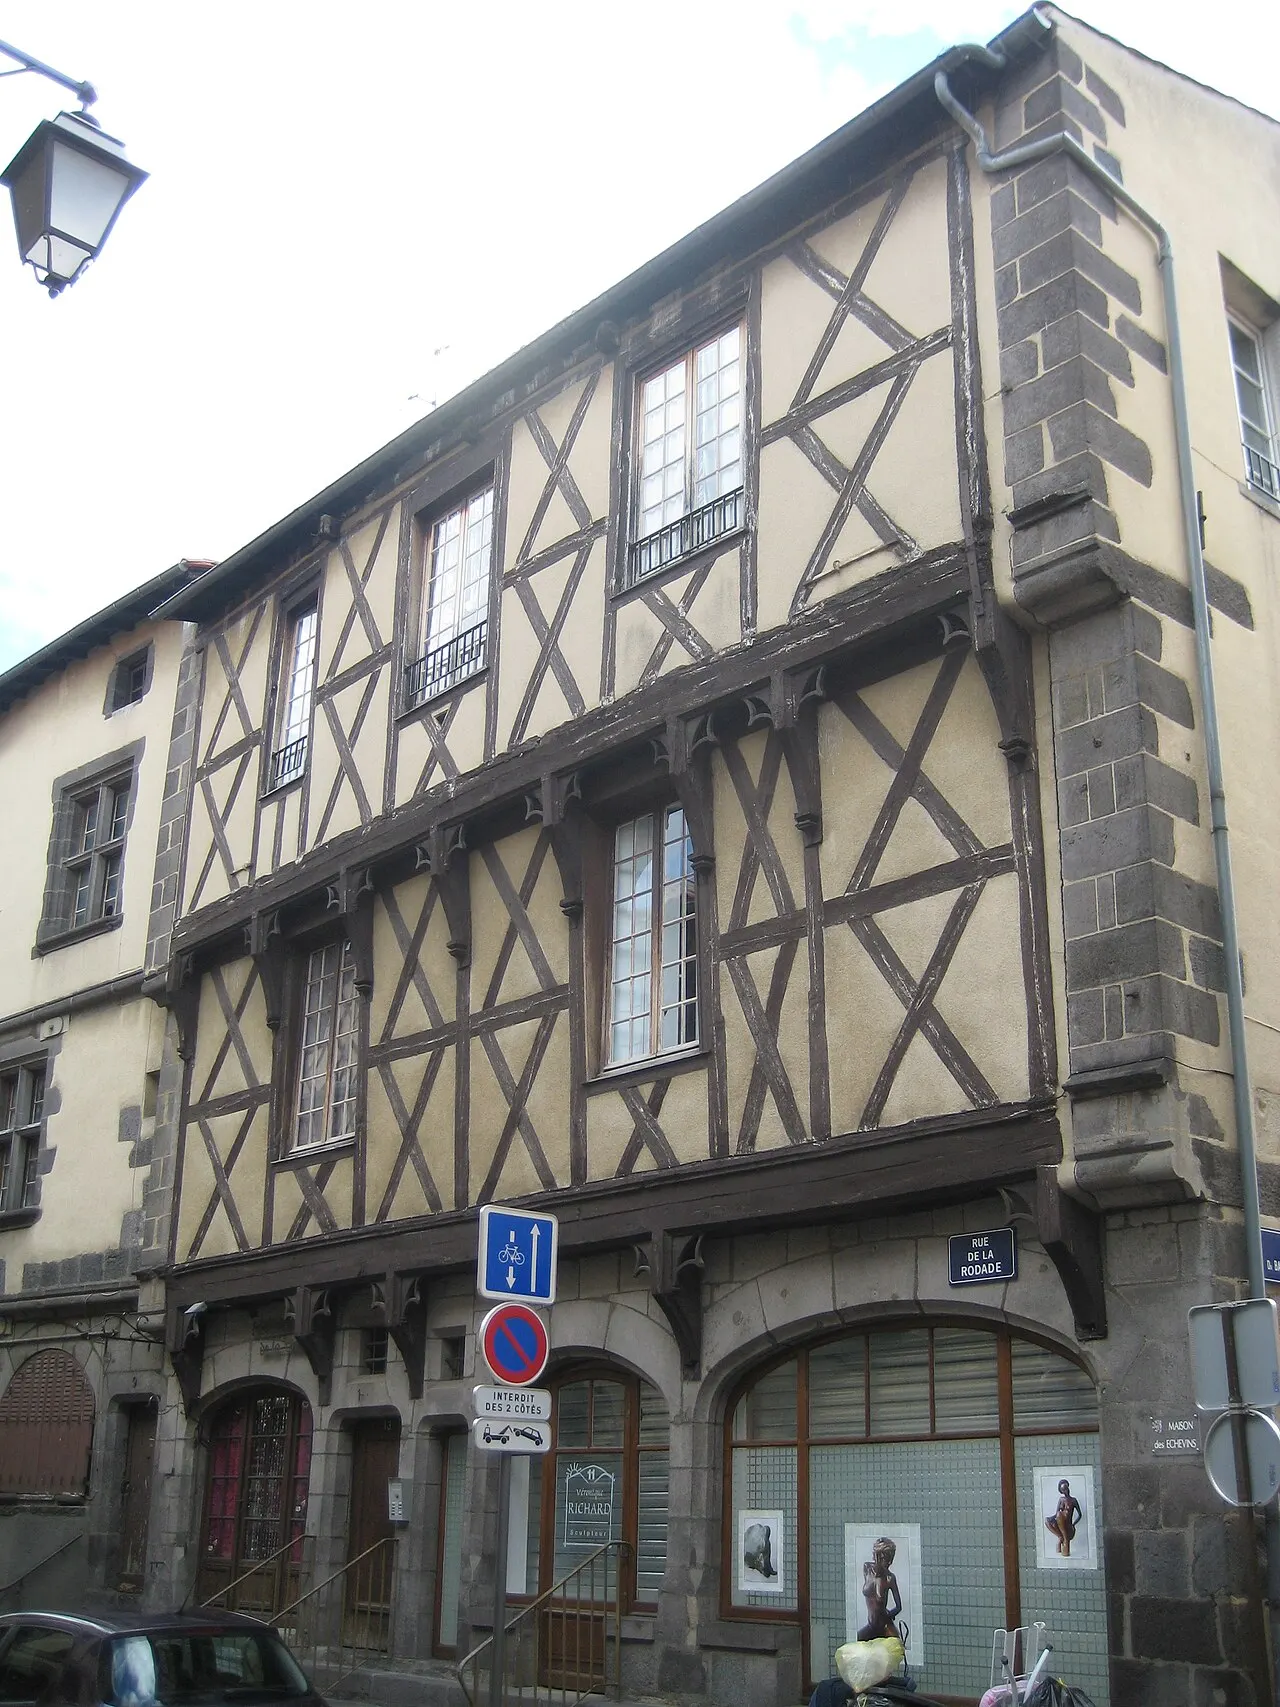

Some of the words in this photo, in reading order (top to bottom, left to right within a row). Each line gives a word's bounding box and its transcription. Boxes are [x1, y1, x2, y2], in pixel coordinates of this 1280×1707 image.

[972, 1237, 989, 1248] RUE
[967, 1251, 980, 1262] DE
[982, 1249, 994, 1260] LA
[961, 1262, 1002, 1277] RODADE
[493, 1391, 535, 1403] INTERDIT
[485, 1402, 503, 1412] DES
[506, 1404, 511, 1413] 2
[514, 1403, 542, 1415] CÔTÉS
[1168, 1420, 1194, 1431] MAISON
[1154, 1440, 1165, 1449] des
[1166, 1438, 1197, 1449] ECHEVINS
[568, 1502, 611, 1515] RICHARD
[570, 1529, 607, 1537] Sculpteur
